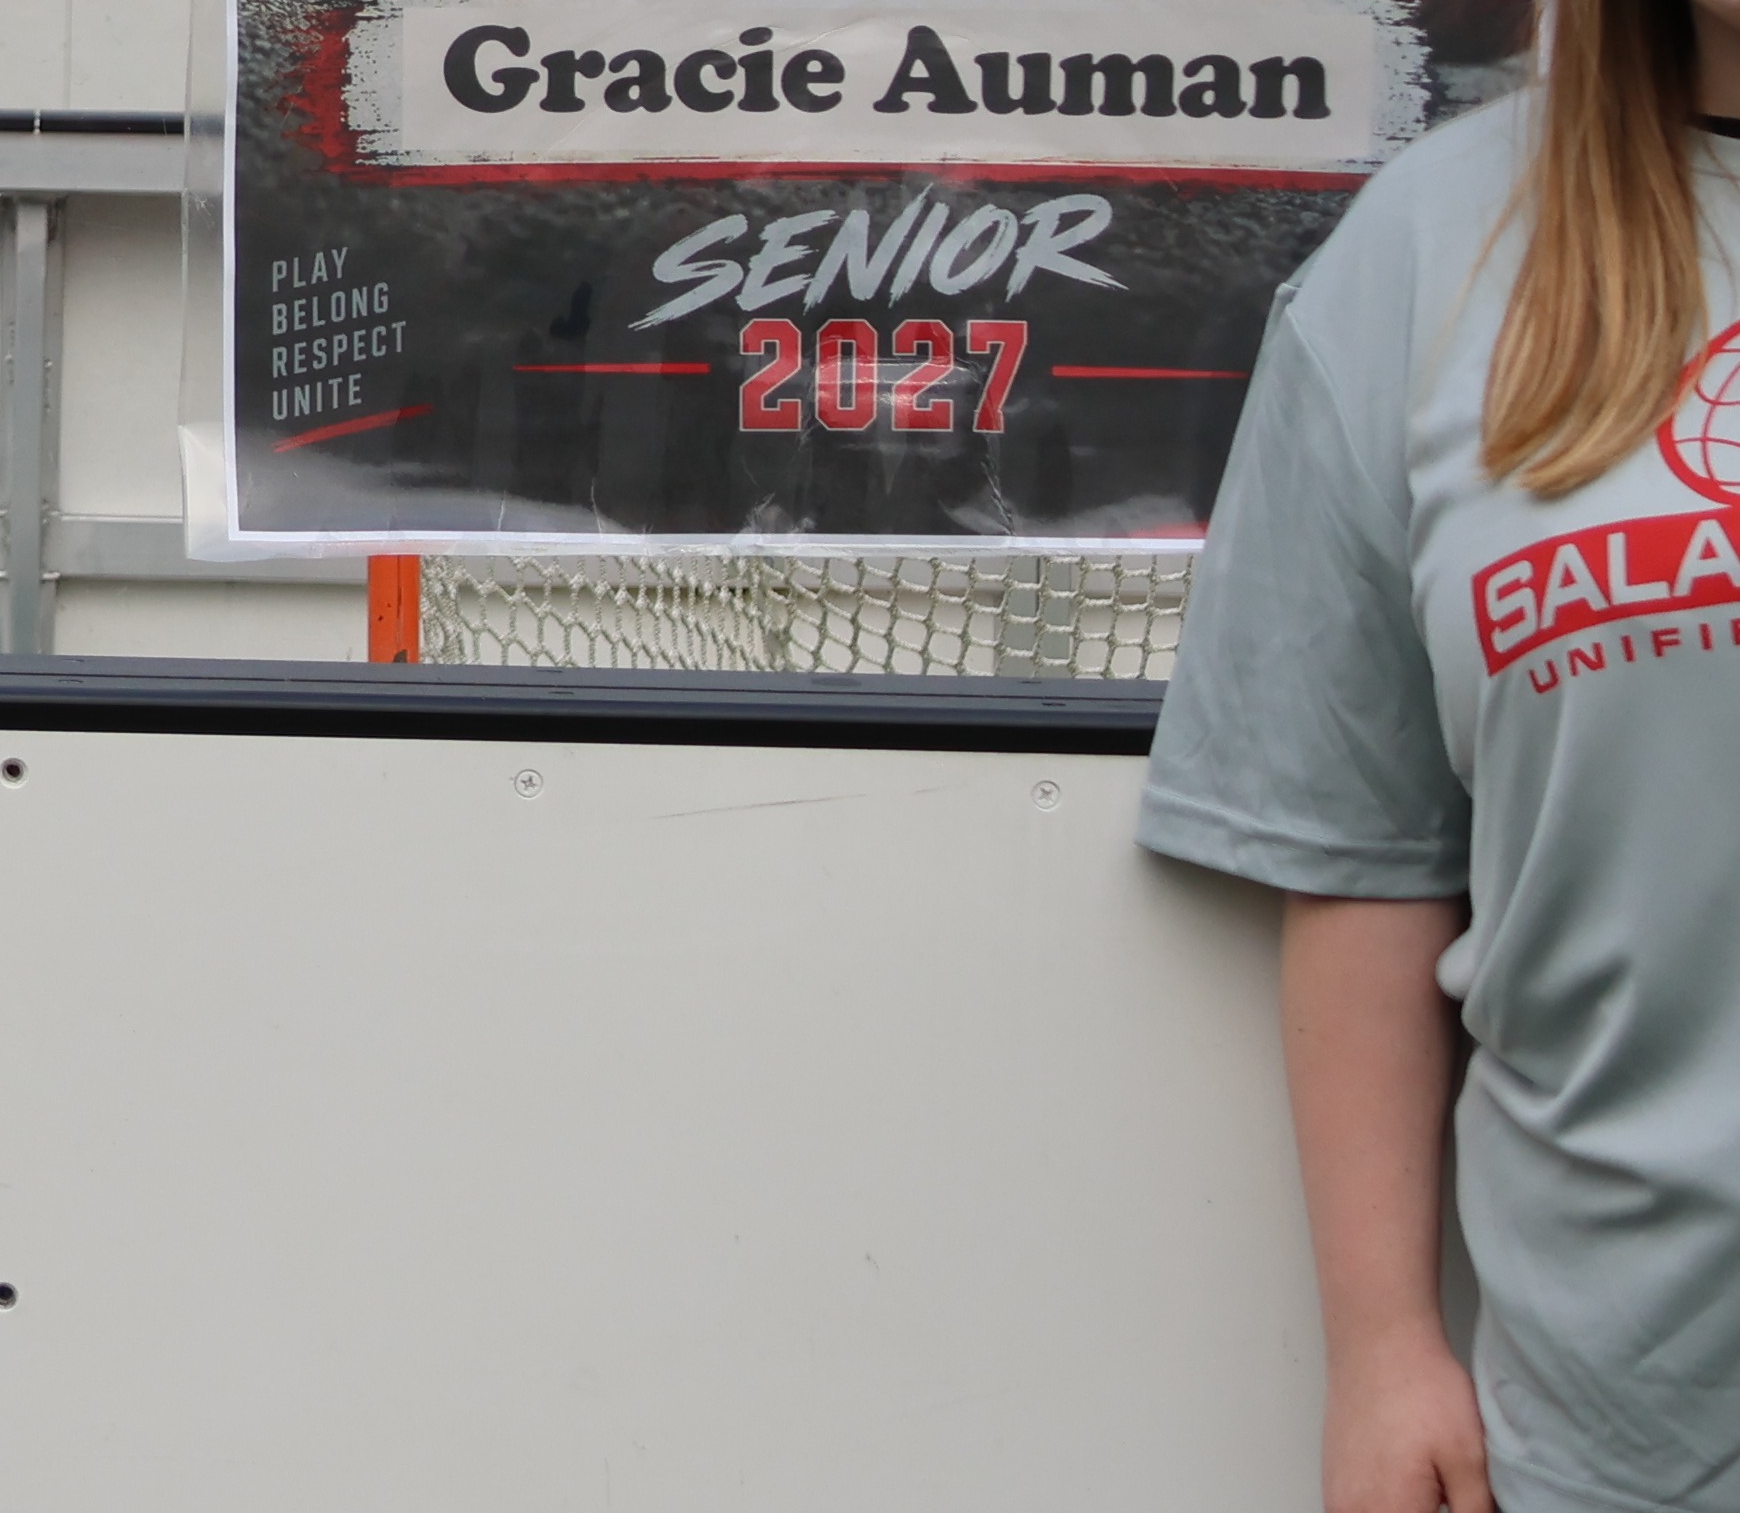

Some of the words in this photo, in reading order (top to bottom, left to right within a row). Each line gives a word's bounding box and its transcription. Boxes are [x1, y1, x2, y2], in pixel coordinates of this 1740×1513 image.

[442, 24, 846, 117] Gracie
[886, 25, 1332, 120] Auman
[272, 246, 348, 293] PLAY
[626, 184, 1129, 332] SENIOR
[272, 282, 389, 336] BELONG
[272, 320, 406, 379] RESPECT
[737, 319, 1030, 434] 2027
[272, 373, 362, 421] UNITE
